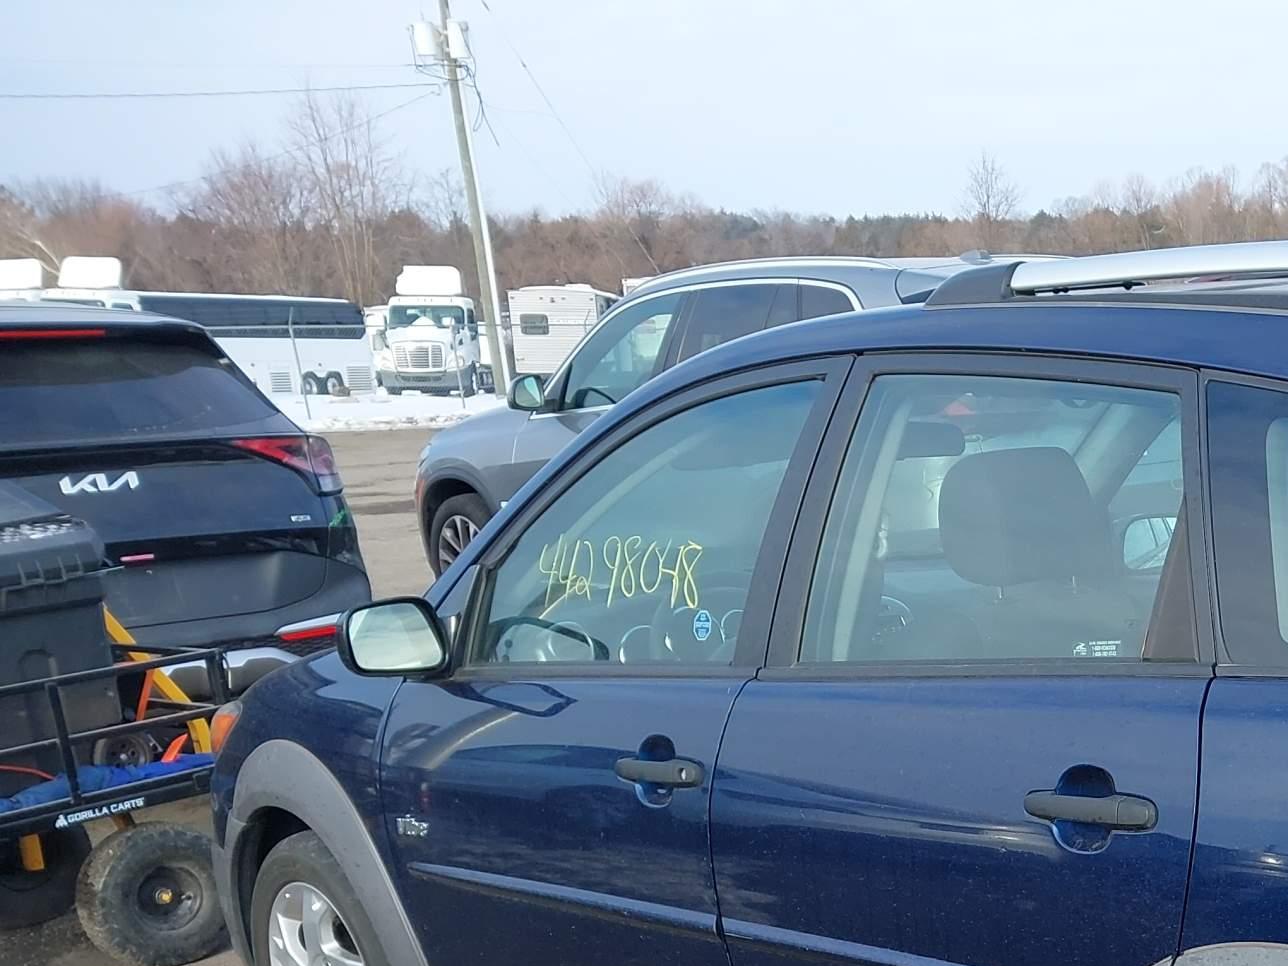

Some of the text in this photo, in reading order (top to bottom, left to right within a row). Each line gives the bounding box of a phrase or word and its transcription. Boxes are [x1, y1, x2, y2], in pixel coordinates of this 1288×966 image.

[59, 471, 139, 494] KIA
[67, 798, 144, 823] GORILLA CARTS
